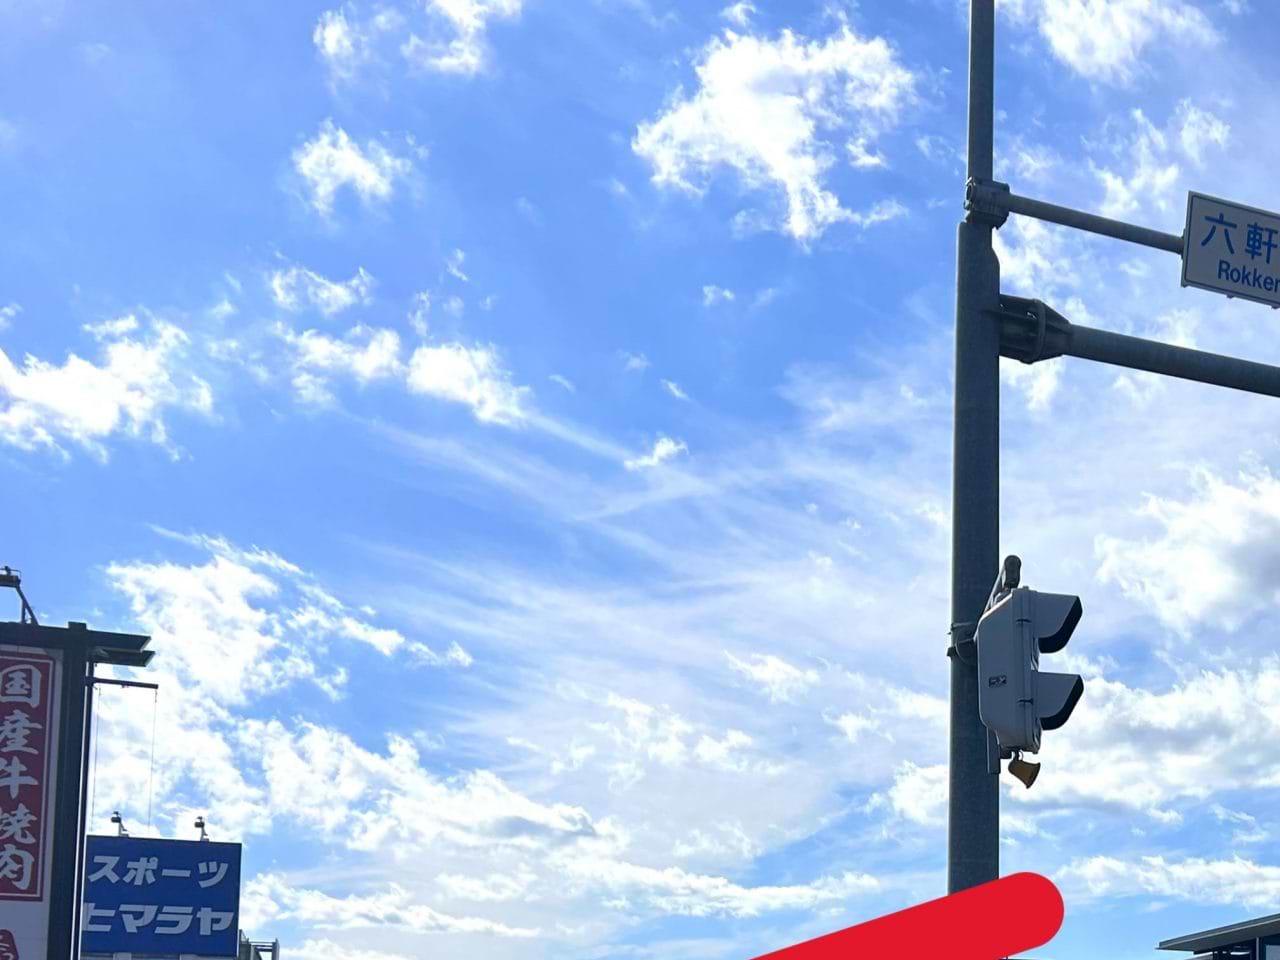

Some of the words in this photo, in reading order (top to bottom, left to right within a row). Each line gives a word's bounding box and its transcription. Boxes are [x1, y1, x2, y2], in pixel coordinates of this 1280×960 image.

[88, 856, 229, 889] スポーツ
[82, 902, 235, 936] ヒマラヤ
